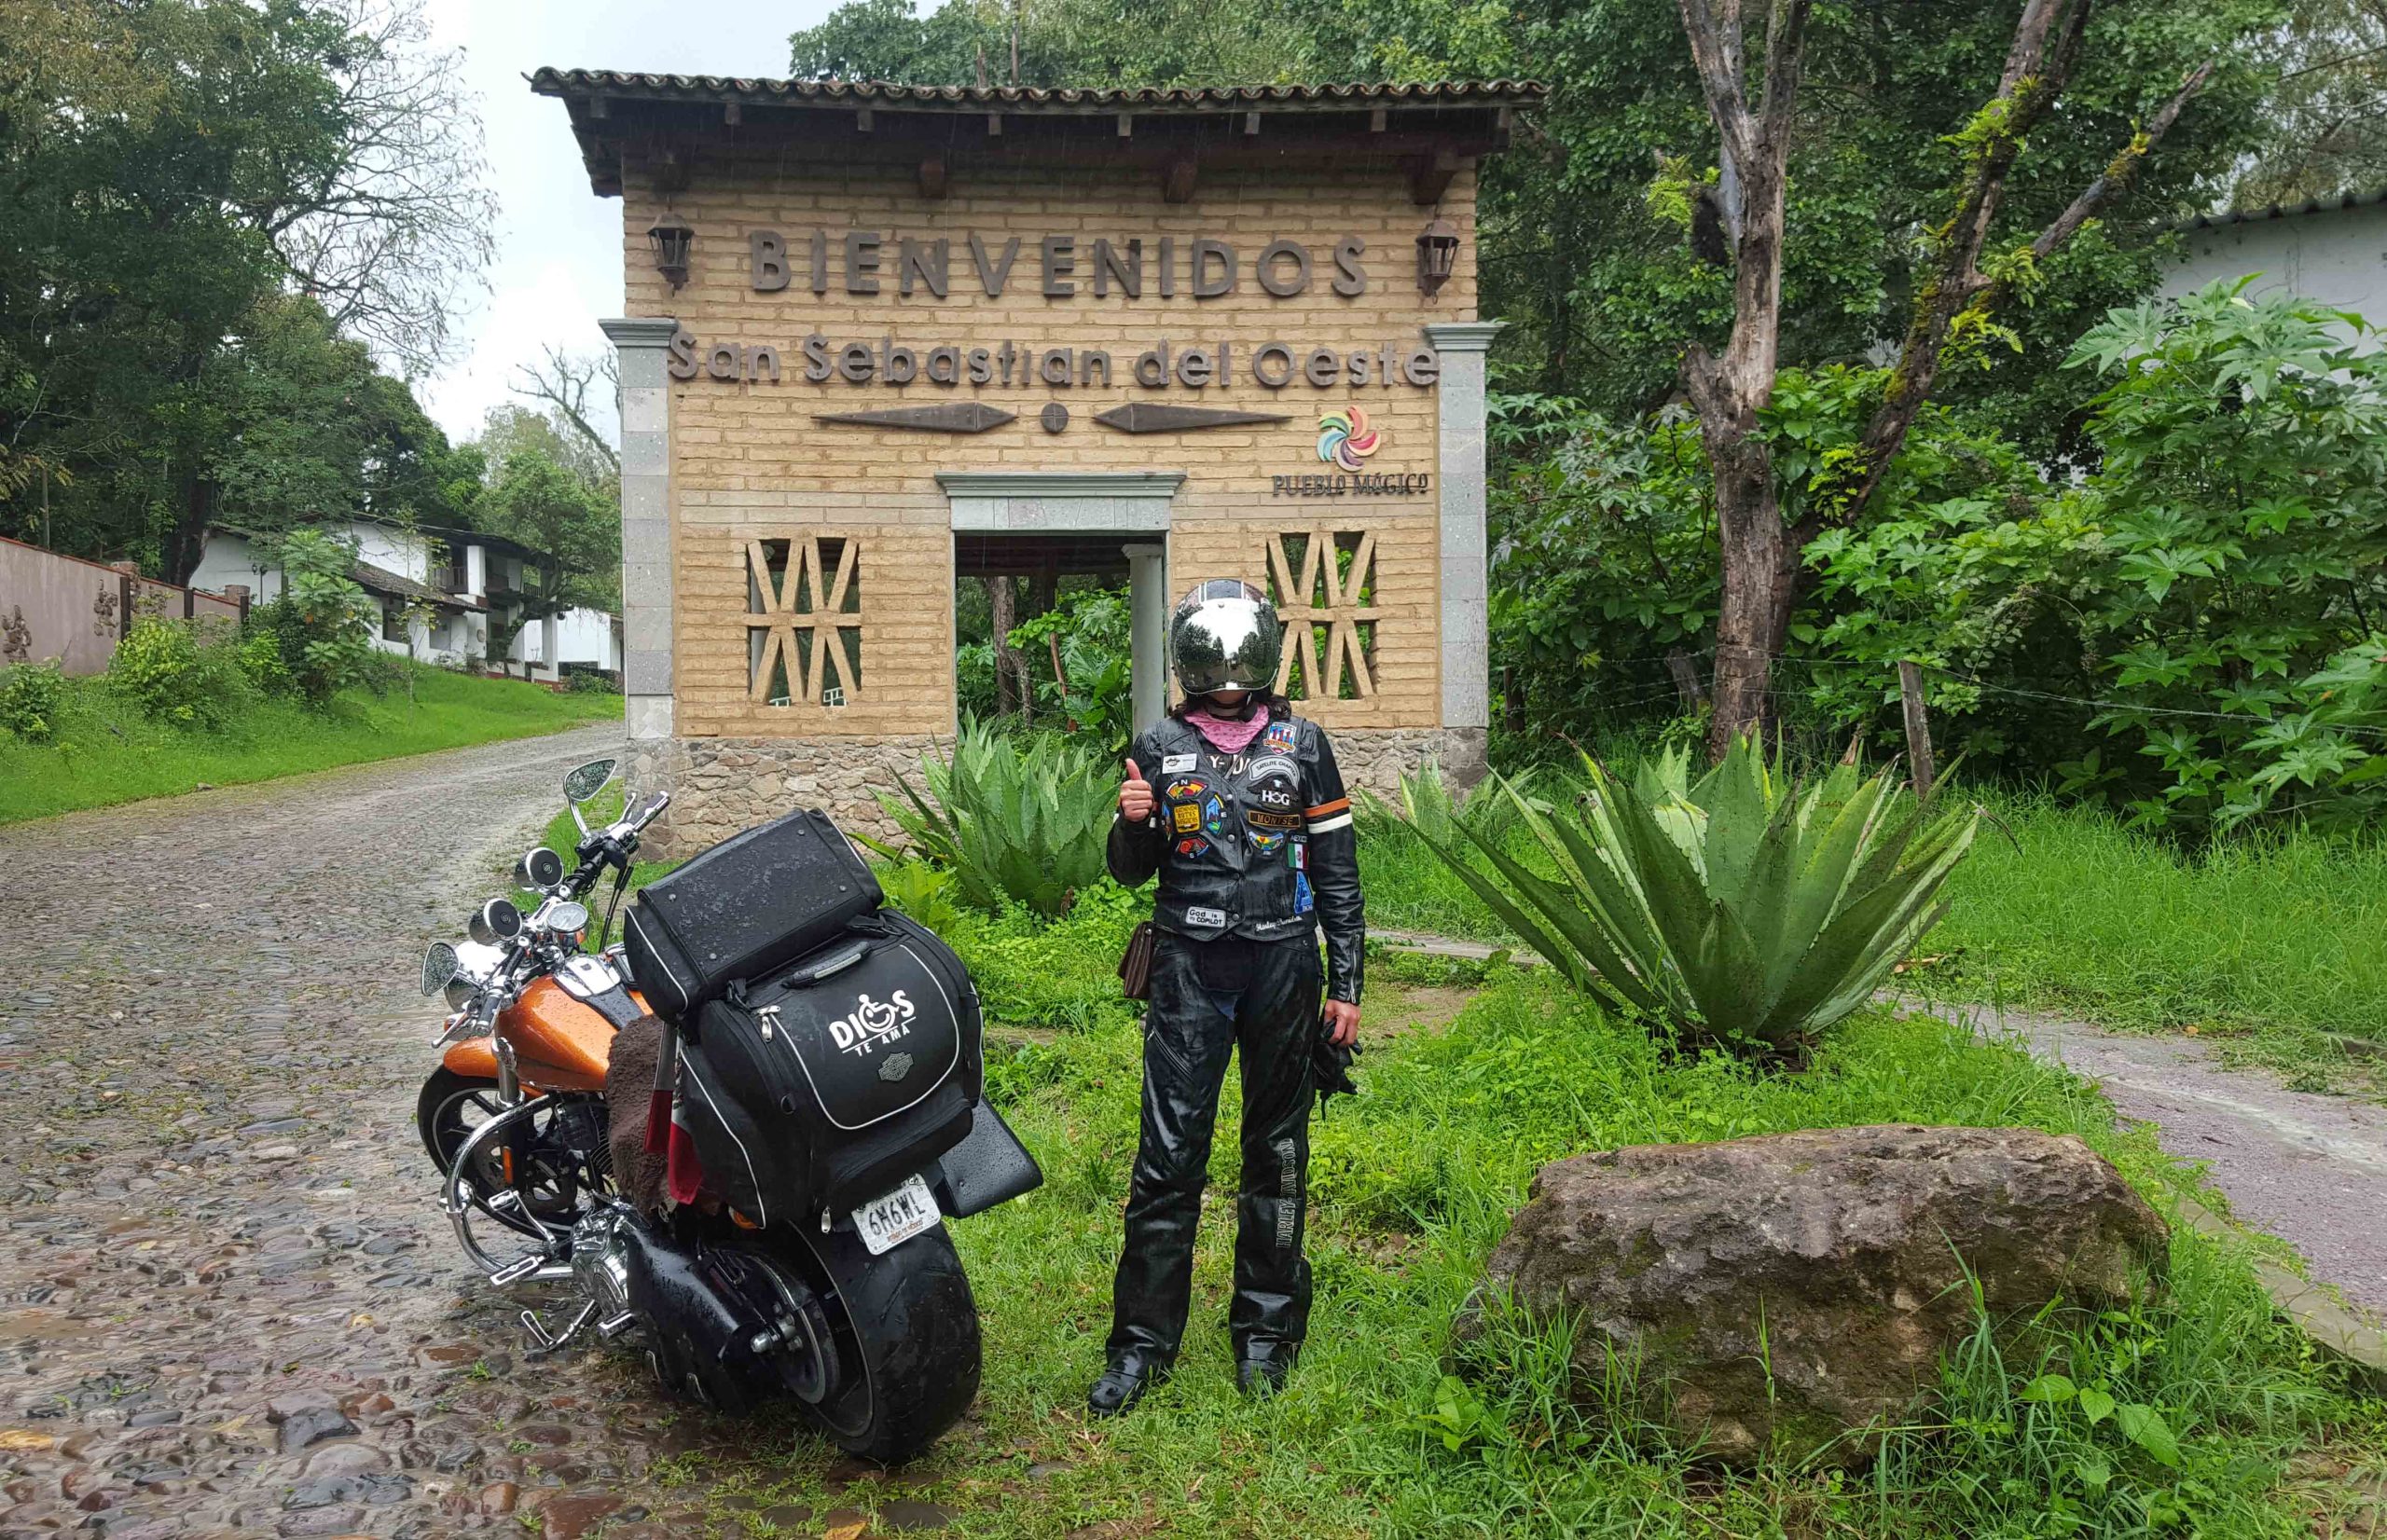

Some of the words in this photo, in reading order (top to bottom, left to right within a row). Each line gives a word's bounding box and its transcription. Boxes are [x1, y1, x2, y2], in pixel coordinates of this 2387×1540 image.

[750, 229, 1367, 298] BIENVENIDOS
[668, 330, 780, 383] San
[803, 332, 1111, 386] Sebastian
[1134, 337, 1231, 388] del
[1252, 341, 1440, 387] Oeste
[1272, 474, 1346, 496] PUEBLO
[1257, 814, 1293, 826] MONTSE
[1189, 909, 1207, 917] God
[854, 1042, 873, 1057] TE
[881, 1024, 911, 1045] AMA
